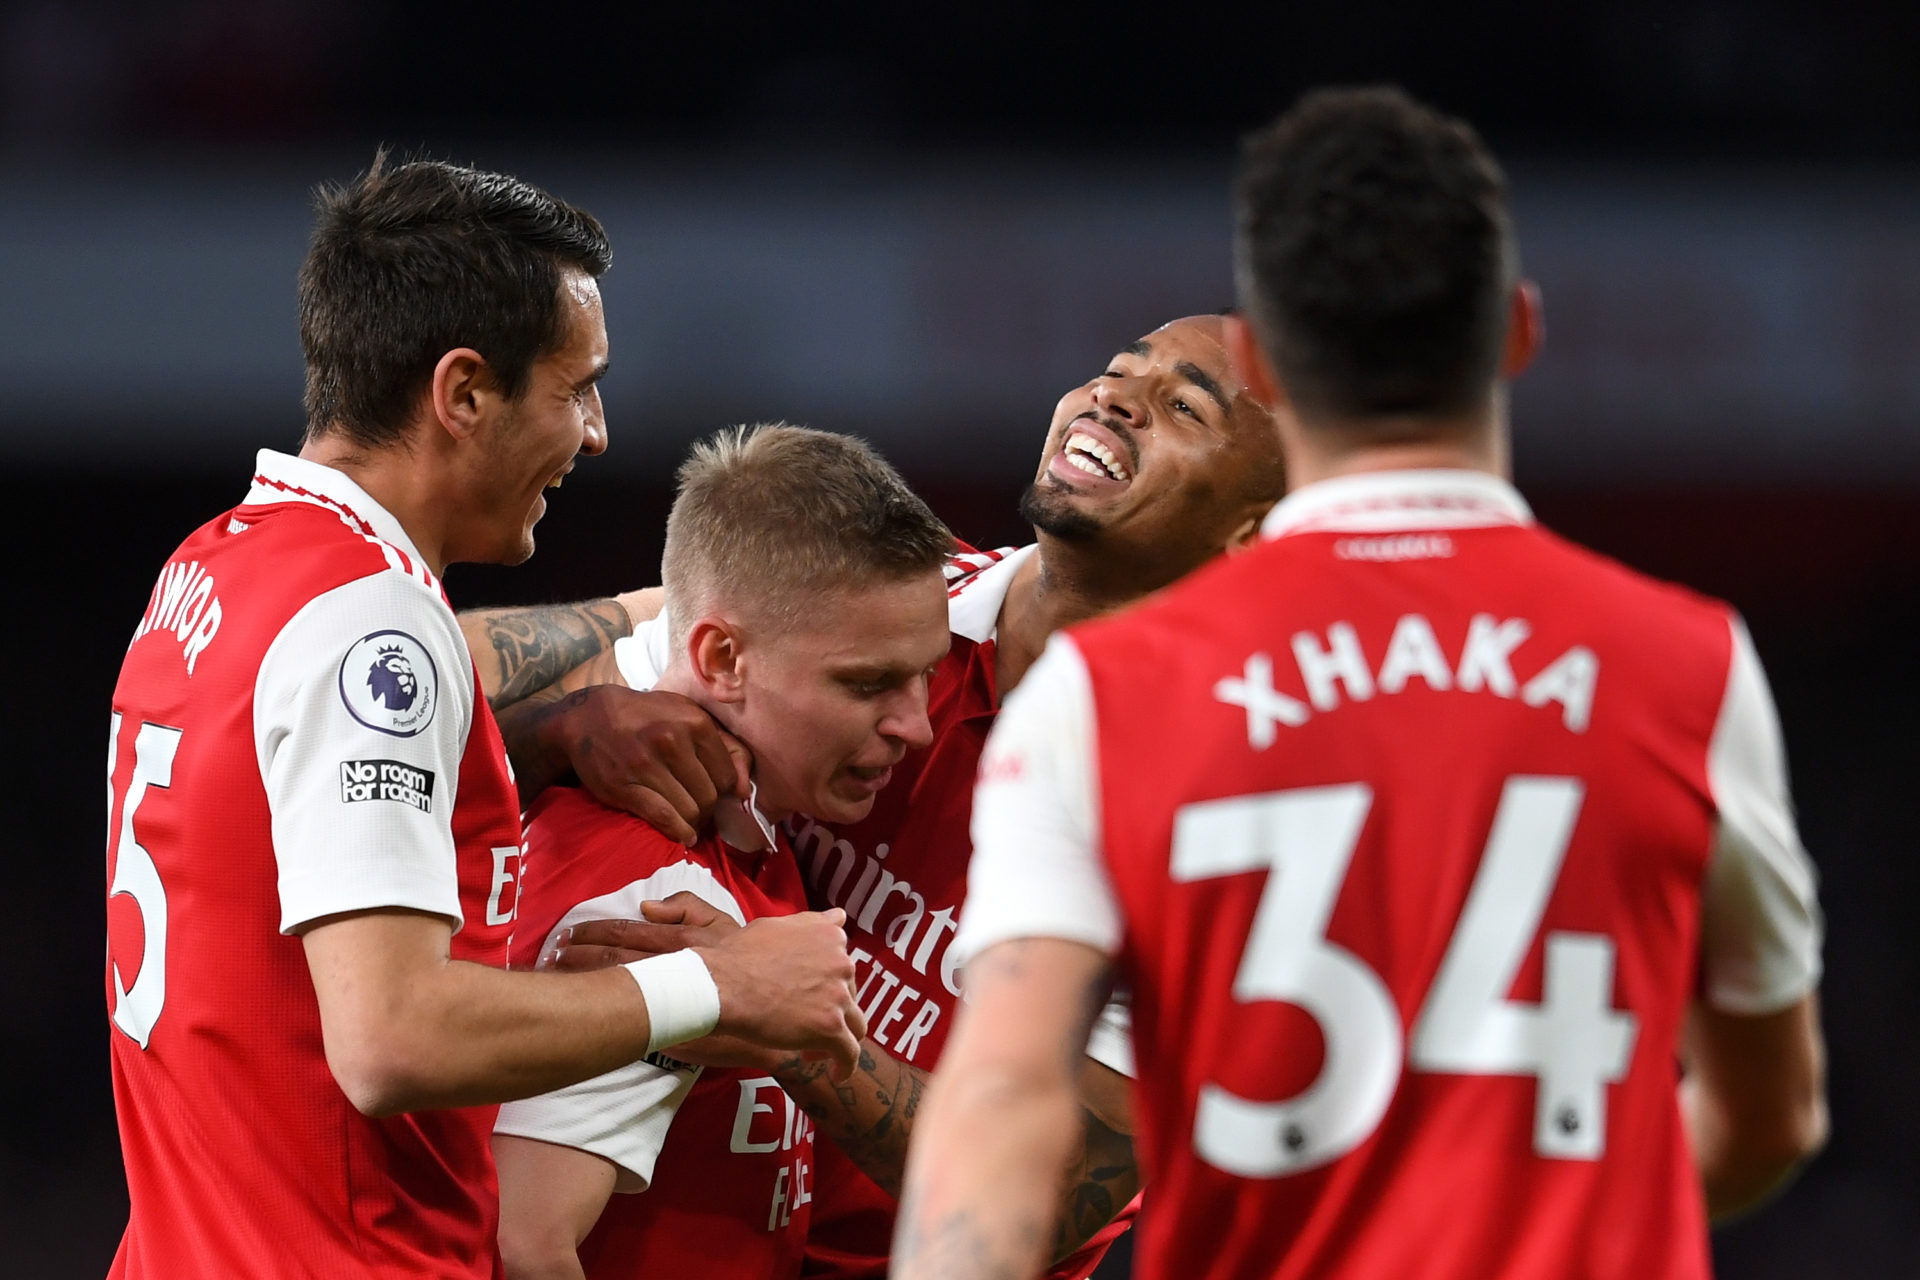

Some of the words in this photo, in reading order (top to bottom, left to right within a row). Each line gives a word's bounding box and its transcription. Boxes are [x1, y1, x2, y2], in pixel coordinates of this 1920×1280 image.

[1213, 613, 1599, 751] XHAKA
[392, 715, 418, 727] Premier
[415, 685, 430, 718] League
[341, 761, 377, 783] No
[380, 764, 426, 791] room
[380, 782, 431, 813] racism
[1168, 774, 1639, 1179] 34
